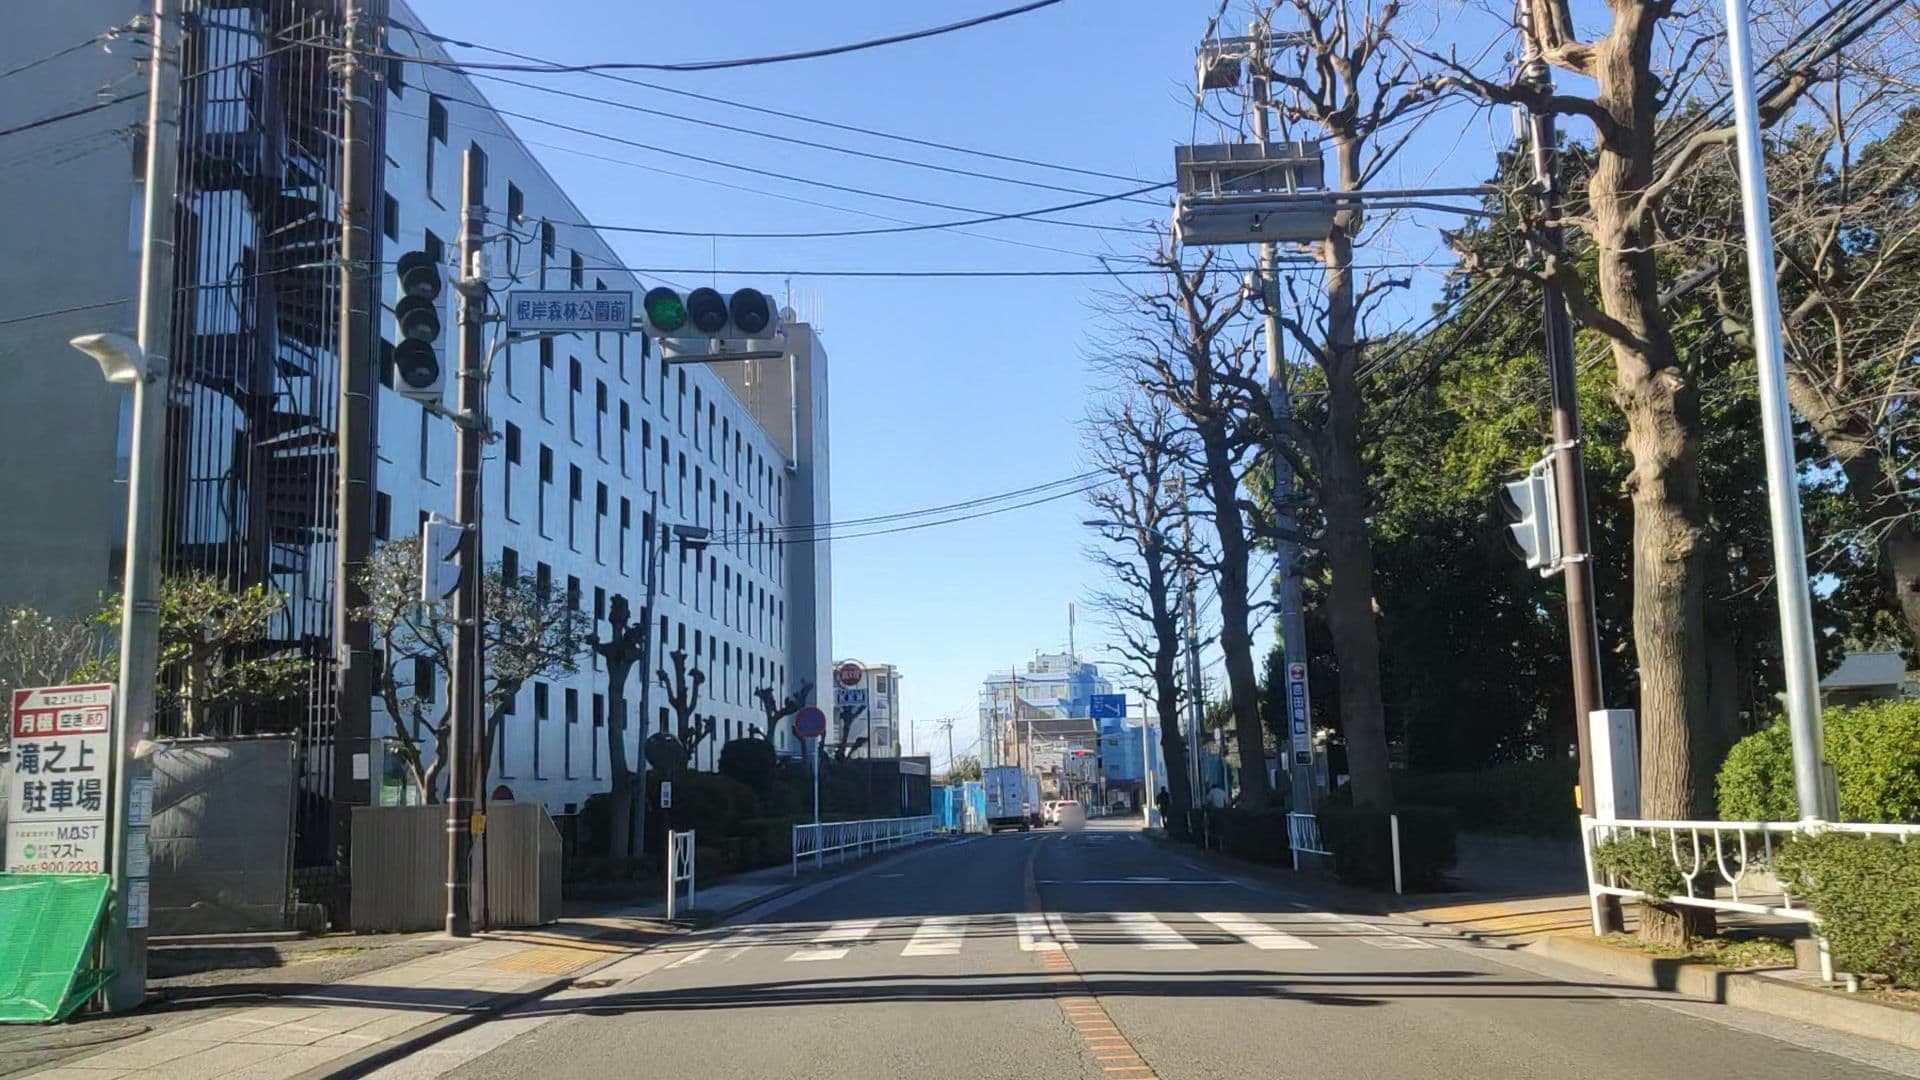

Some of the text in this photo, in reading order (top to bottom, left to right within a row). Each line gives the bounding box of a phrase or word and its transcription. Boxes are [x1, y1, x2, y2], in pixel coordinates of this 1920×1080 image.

[517, 300, 626, 322] 根岸森林公園前
[15, 739, 95, 774] 滝之上
[22, 779, 102, 813] 駐車場
[49, 843, 84, 858] マスト
